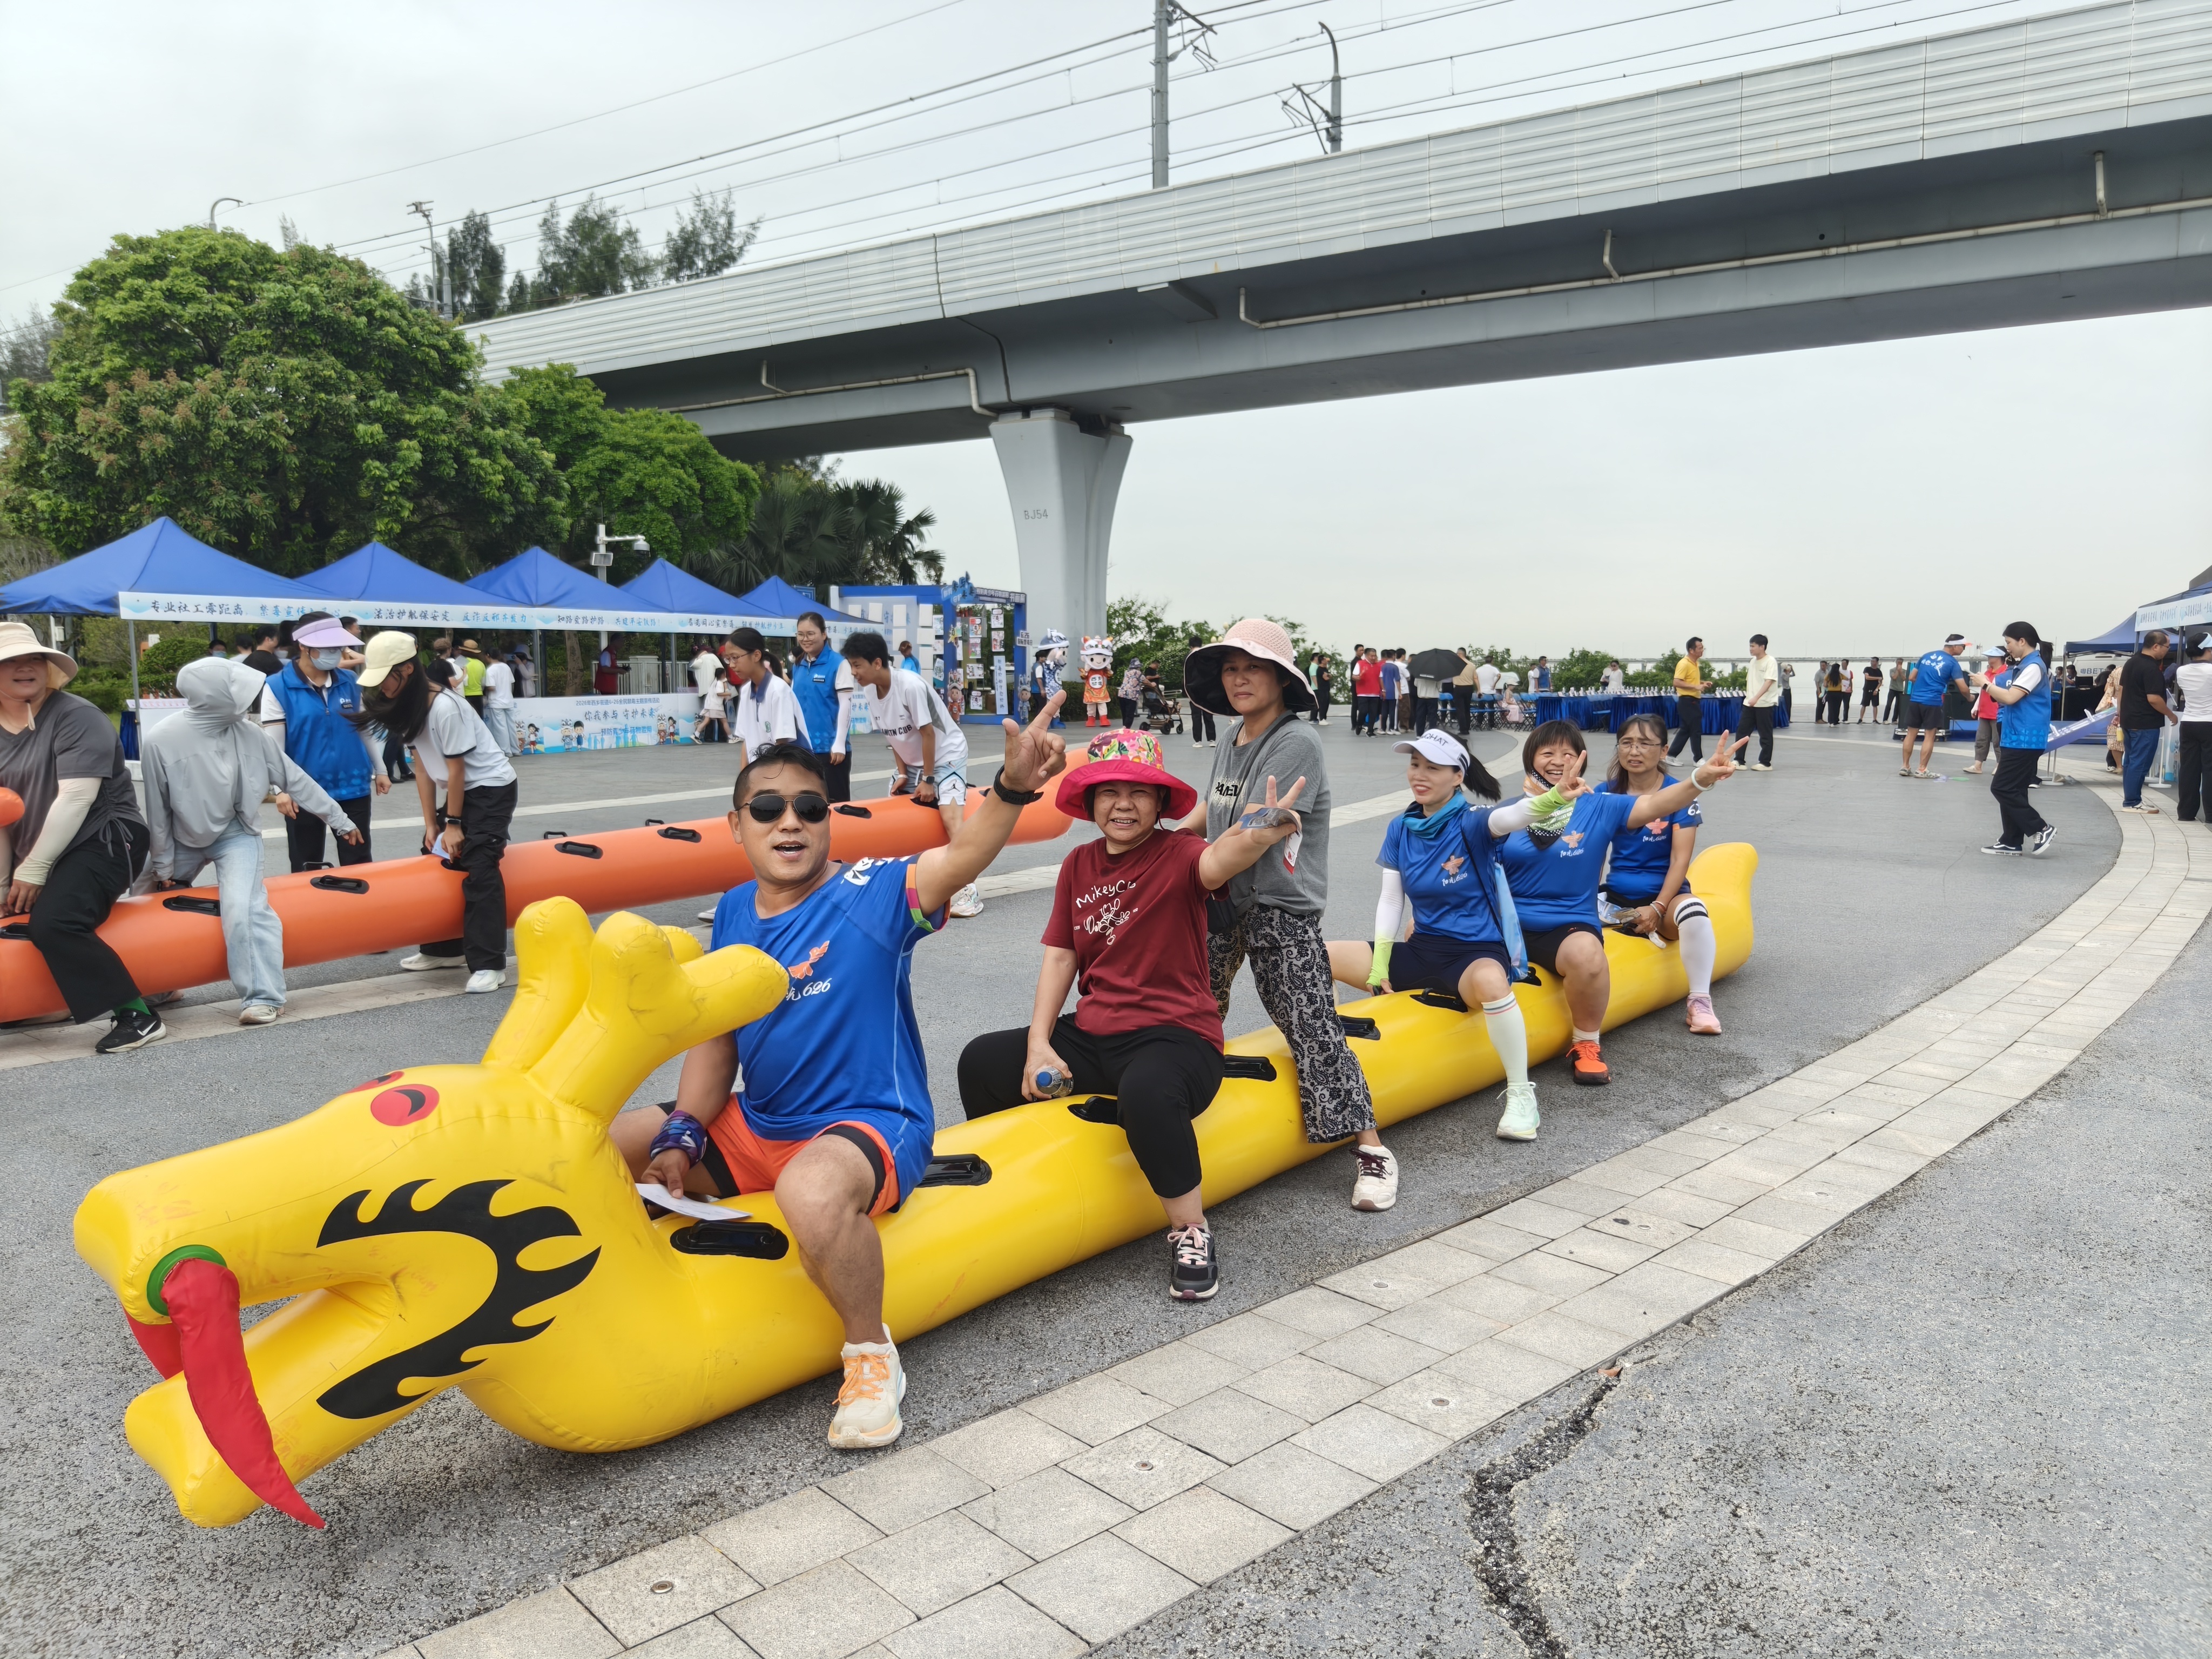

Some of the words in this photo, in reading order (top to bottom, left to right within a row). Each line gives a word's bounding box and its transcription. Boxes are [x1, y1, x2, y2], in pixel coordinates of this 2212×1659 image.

[1024, 509, 1048, 520] BJ54
[260, 603, 341, 617] 禁毒宣传心
[584, 710, 618, 721] 你我参与
[623, 706, 656, 720] 守护未来
[1076, 880, 1136, 908] MikeyC
